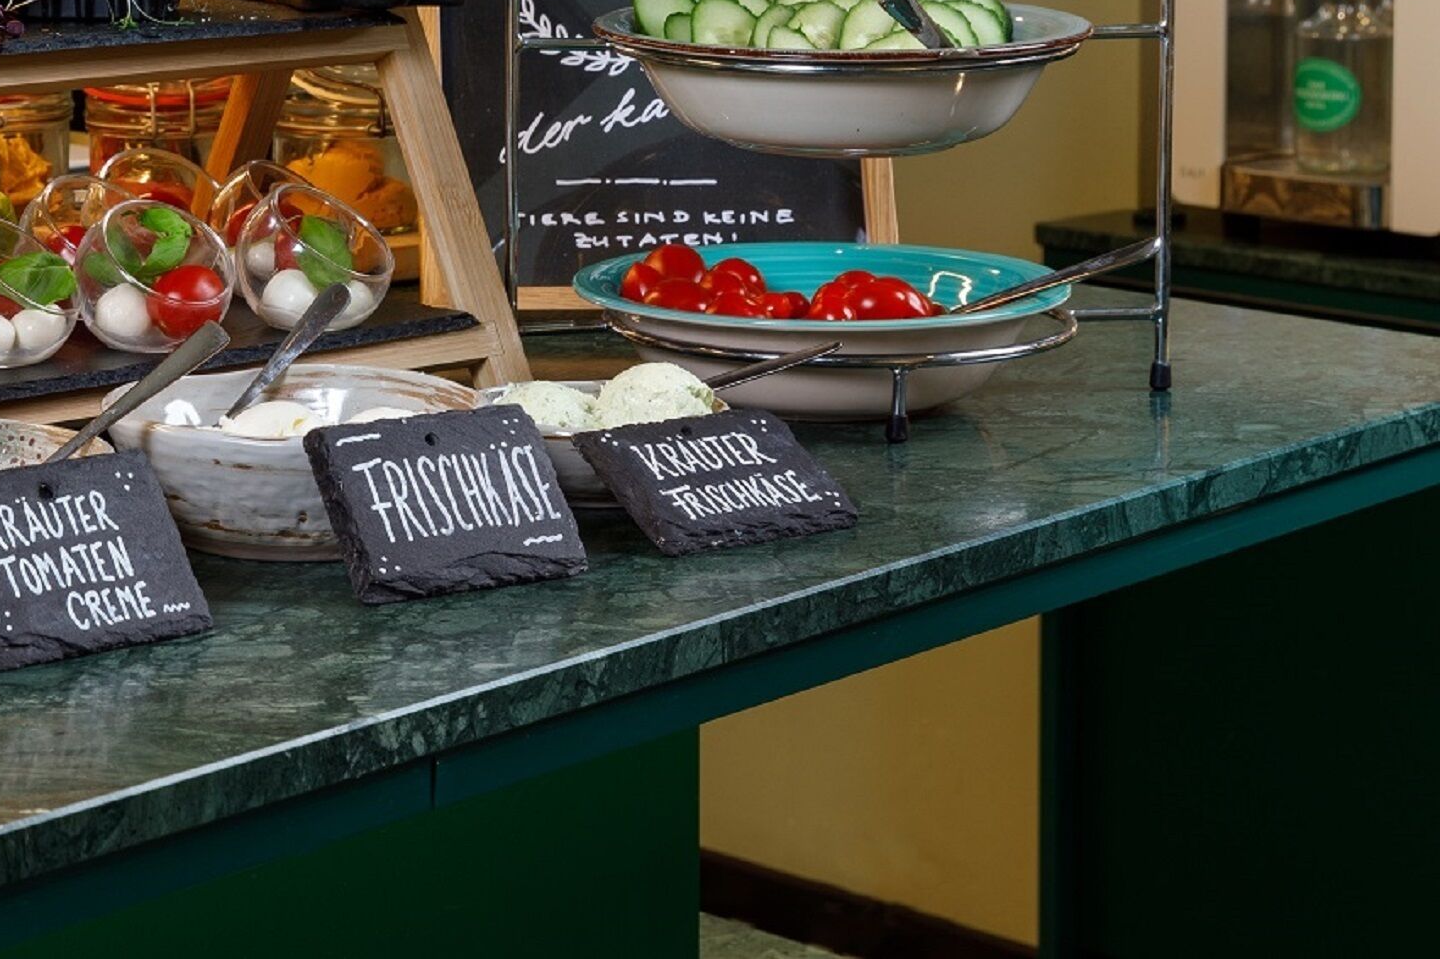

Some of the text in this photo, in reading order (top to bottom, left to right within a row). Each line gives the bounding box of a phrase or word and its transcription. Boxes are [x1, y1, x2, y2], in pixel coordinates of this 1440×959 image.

[600, 87, 670, 133] ka
[517, 209, 795, 226] TIERE SIND KEINE
[630, 430, 778, 482] KRÄUTER
[351, 440, 562, 544] FRISCHKÄSE
[658, 468, 823, 521] FRISCHKÄSE
[66, 580, 158, 631] CREME
